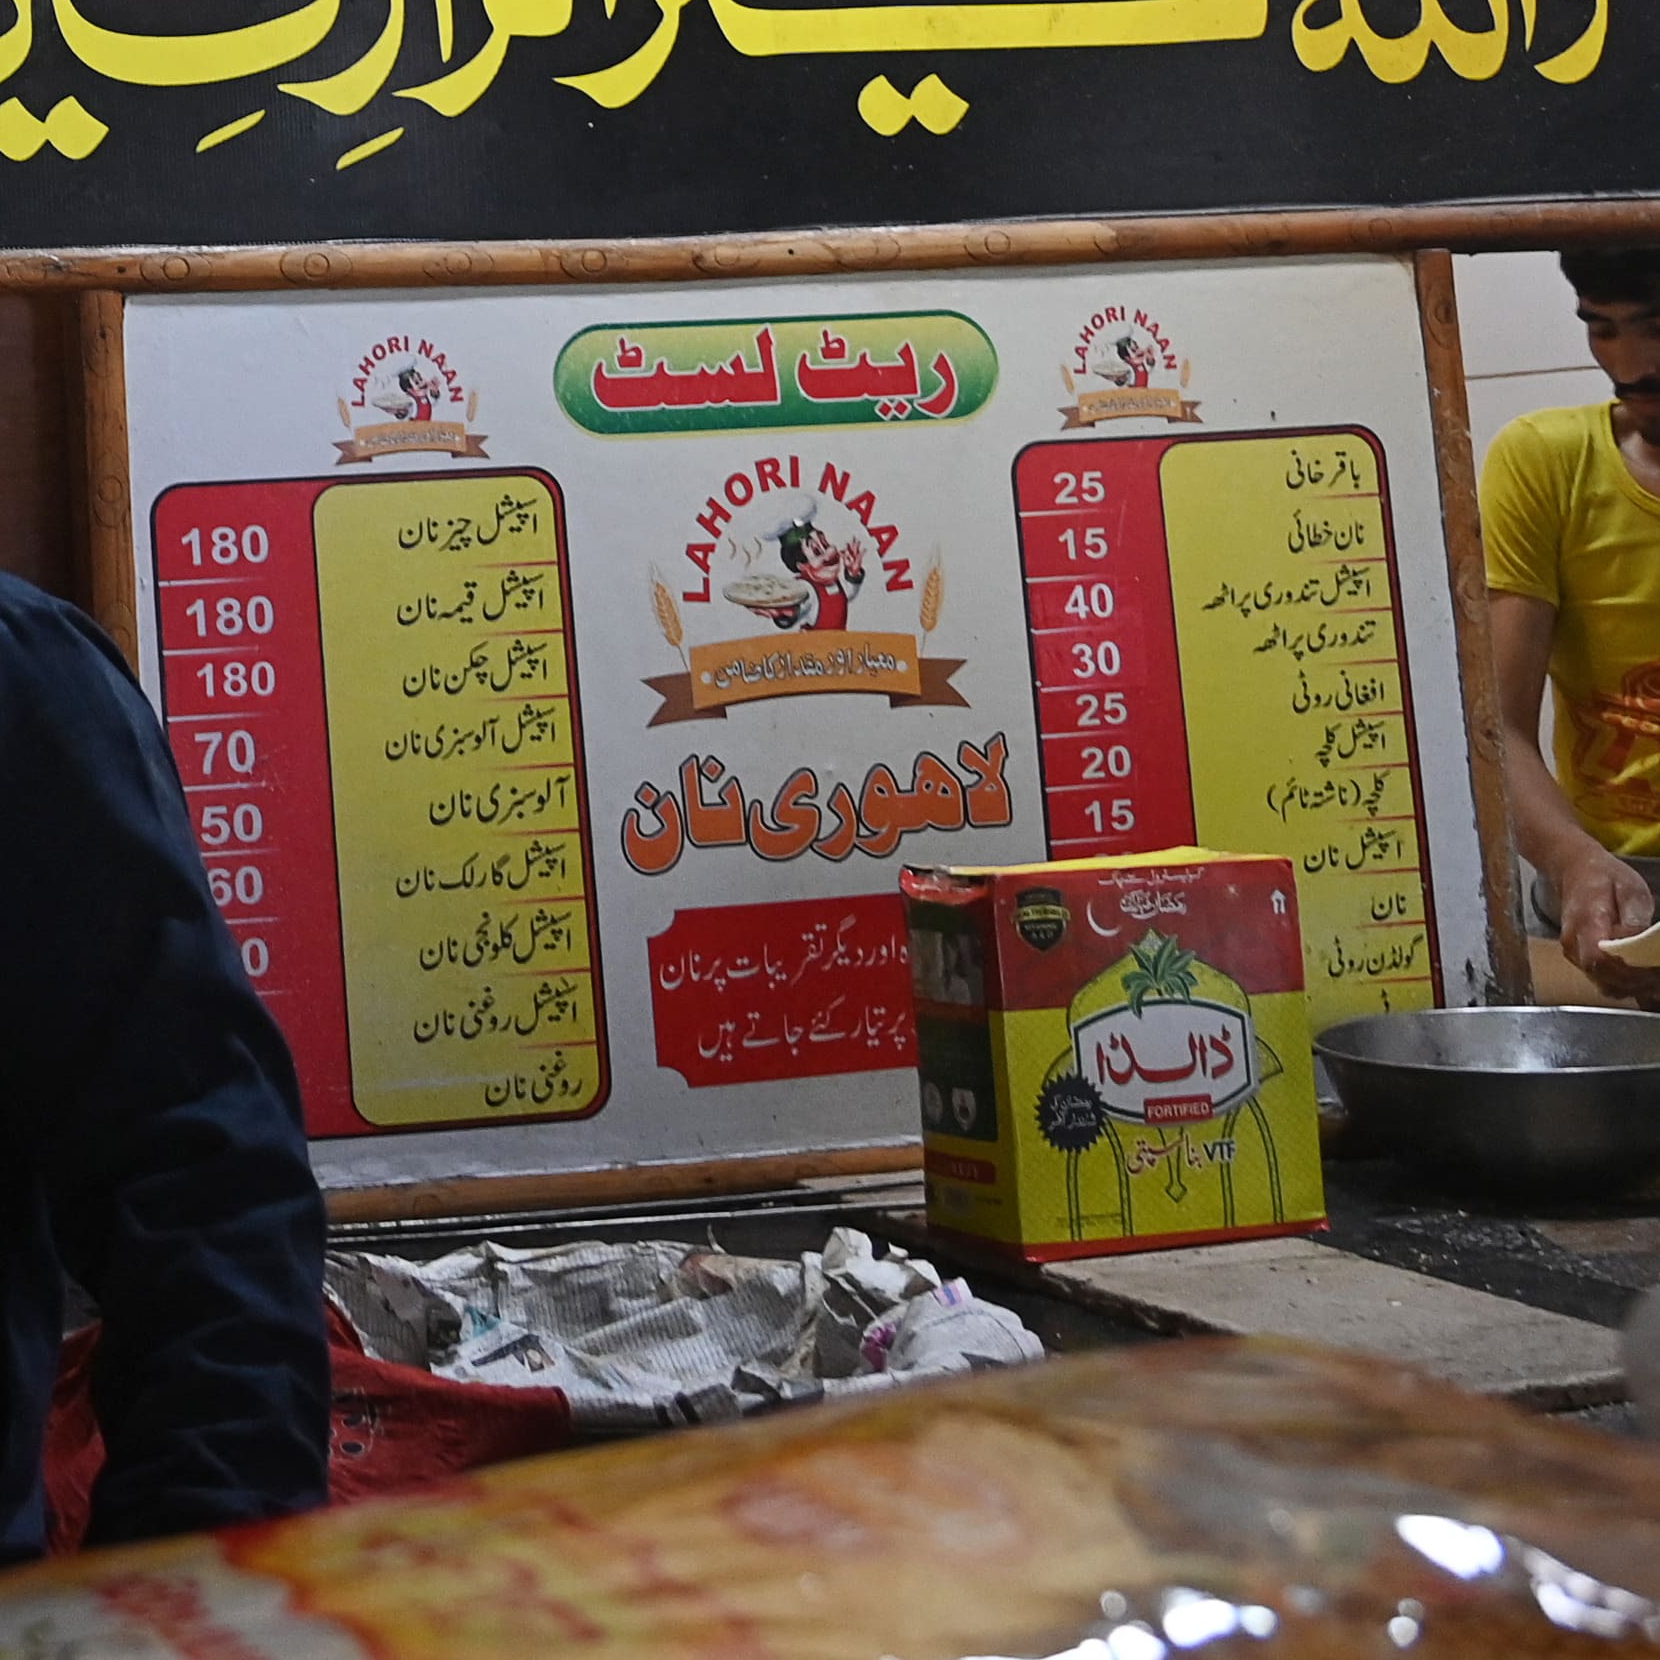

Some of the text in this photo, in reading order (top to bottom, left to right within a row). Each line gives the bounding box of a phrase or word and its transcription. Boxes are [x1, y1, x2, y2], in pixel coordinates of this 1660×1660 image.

[1074, 305, 1177, 374] LAHORI NAAN
[351, 335, 464, 407] LAHORI NAAN
[592, 324, 959, 420] ریٹ لسٹ
[1053, 470, 1106, 505] 25
[398, 517, 438, 549] نان
[477, 494, 538, 545] اسپیشل
[683, 455, 915, 603] LAHORI NAAN
[1334, 521, 1364, 551] نان
[180, 524, 269, 566] 180
[1059, 527, 1108, 561] 15
[483, 570, 545, 621] اسپیشل
[1064, 583, 1115, 619] 40
[1320, 564, 1370, 606] اسپیشل
[185, 595, 274, 637] 180
[397, 594, 437, 626] نان
[195, 661, 276, 698] 180
[490, 639, 548, 692] اسپیشل
[1072, 641, 1122, 677] 30
[403, 665, 440, 697] نان
[501, 703, 556, 753] اسپیشل
[1076, 693, 1129, 727] 25
[193, 731, 256, 775] 70
[385, 730, 421, 761] نان
[1337, 718, 1386, 759] اسپیشل
[1081, 745, 1132, 780] 20
[199, 803, 263, 845] 50
[430, 789, 472, 826] نان
[621, 753, 748, 876] نان
[1085, 799, 1136, 833] 15
[507, 839, 566, 890] اسپیشل
[1303, 827, 1402, 873] اسپیشل نان
[210, 865, 263, 906] 60
[396, 865, 435, 898] نان
[1371, 893, 1407, 921] نان
[419, 936, 458, 971] نان
[512, 909, 572, 964] اسپیشل
[659, 948, 702, 990] نان
[413, 1009, 455, 1043] نان
[514, 976, 578, 1036] اسپیشل
[697, 1019, 736, 1063] ہیں
[484, 1073, 526, 1108] نان
[1147, 1101, 1210, 1120] FORTIFIED
